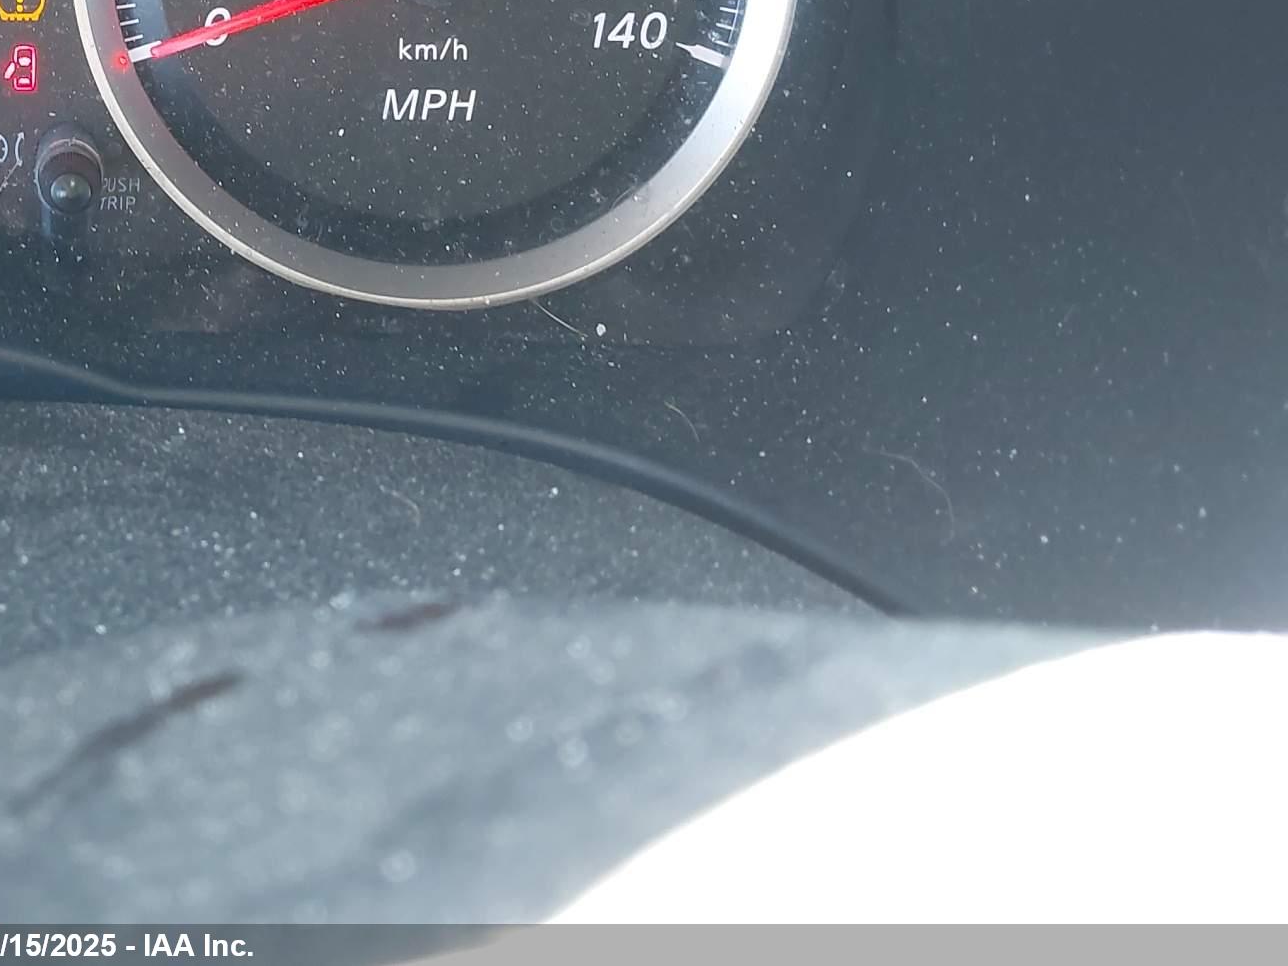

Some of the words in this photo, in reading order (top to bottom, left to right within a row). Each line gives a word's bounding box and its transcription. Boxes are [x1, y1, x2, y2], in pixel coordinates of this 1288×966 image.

[204, 6, 232, 47] 0
[593, 11, 668, 50] 140
[398, 37, 468, 61] km/h
[382, 88, 477, 122] MPH
